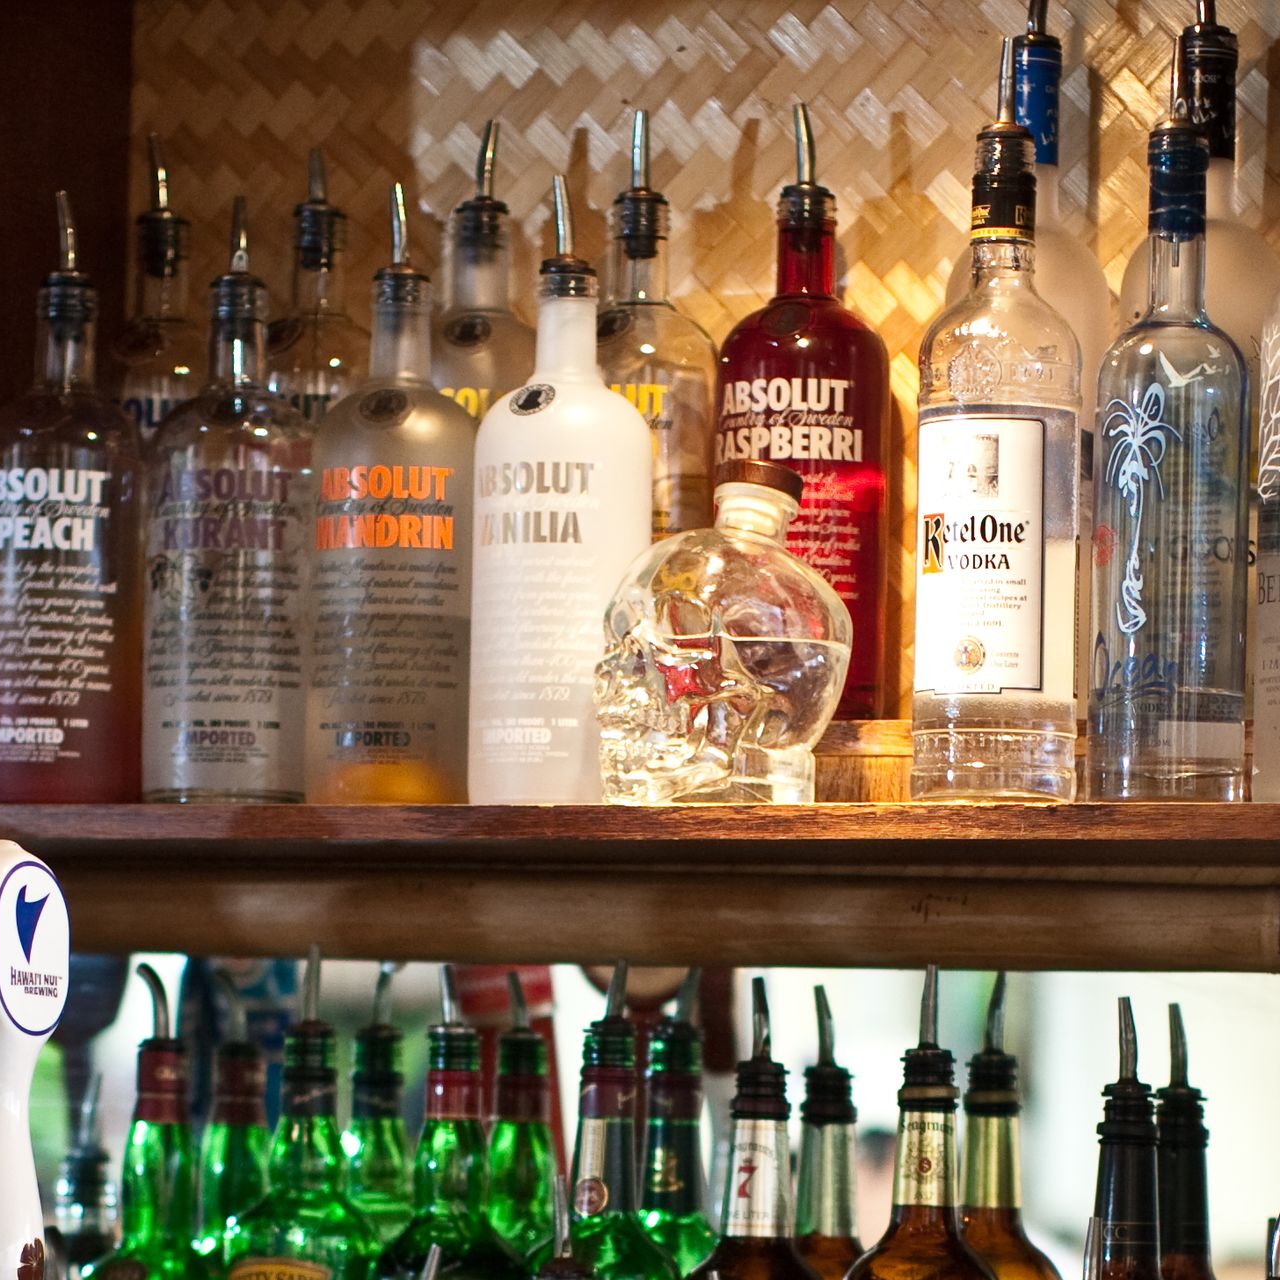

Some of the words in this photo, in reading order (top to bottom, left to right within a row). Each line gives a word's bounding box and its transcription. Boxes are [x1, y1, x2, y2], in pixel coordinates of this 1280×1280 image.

[722, 378, 849, 416] ABSOLUT
[716, 426, 863, 467] RASPBERRI
[163, 468, 293, 502] ABSOLUT
[322, 465, 450, 500] ABSOLUT
[480, 460, 595, 498] ABSOLUT
[161, 517, 288, 550] KURANT
[315, 514, 455, 550] MANDRIN
[924, 514, 976, 569] Ketel
[980, 514, 1025, 544] One
[948, 553, 1011, 570] VODKA
[24, 986, 58, 998] BREWING
[43, 973, 58, 986] NUI
[737, 1165, 759, 1199] 7
